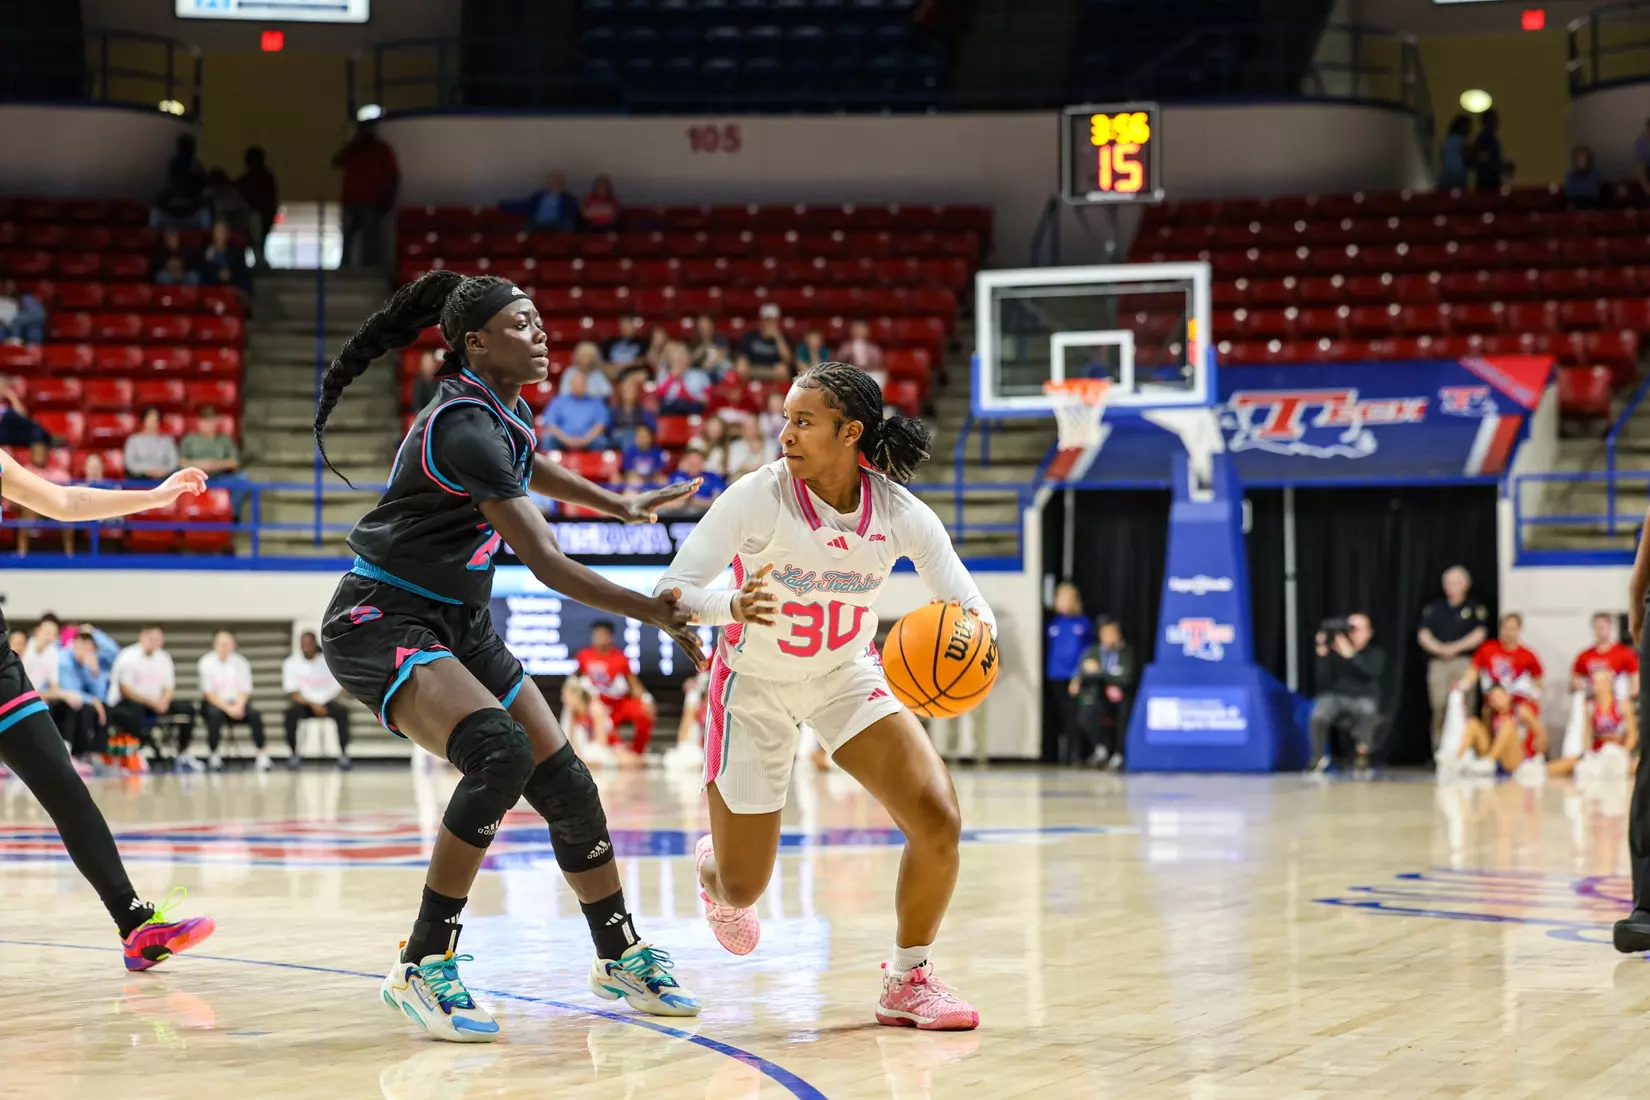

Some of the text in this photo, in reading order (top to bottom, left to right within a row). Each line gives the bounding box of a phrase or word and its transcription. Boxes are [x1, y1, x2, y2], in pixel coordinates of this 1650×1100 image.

[685, 124, 742, 154] 105
[1098, 144, 1143, 193] 15
[772, 564, 817, 596] Lady
[777, 600, 869, 657] 30
[944, 609, 973, 661] Wil
